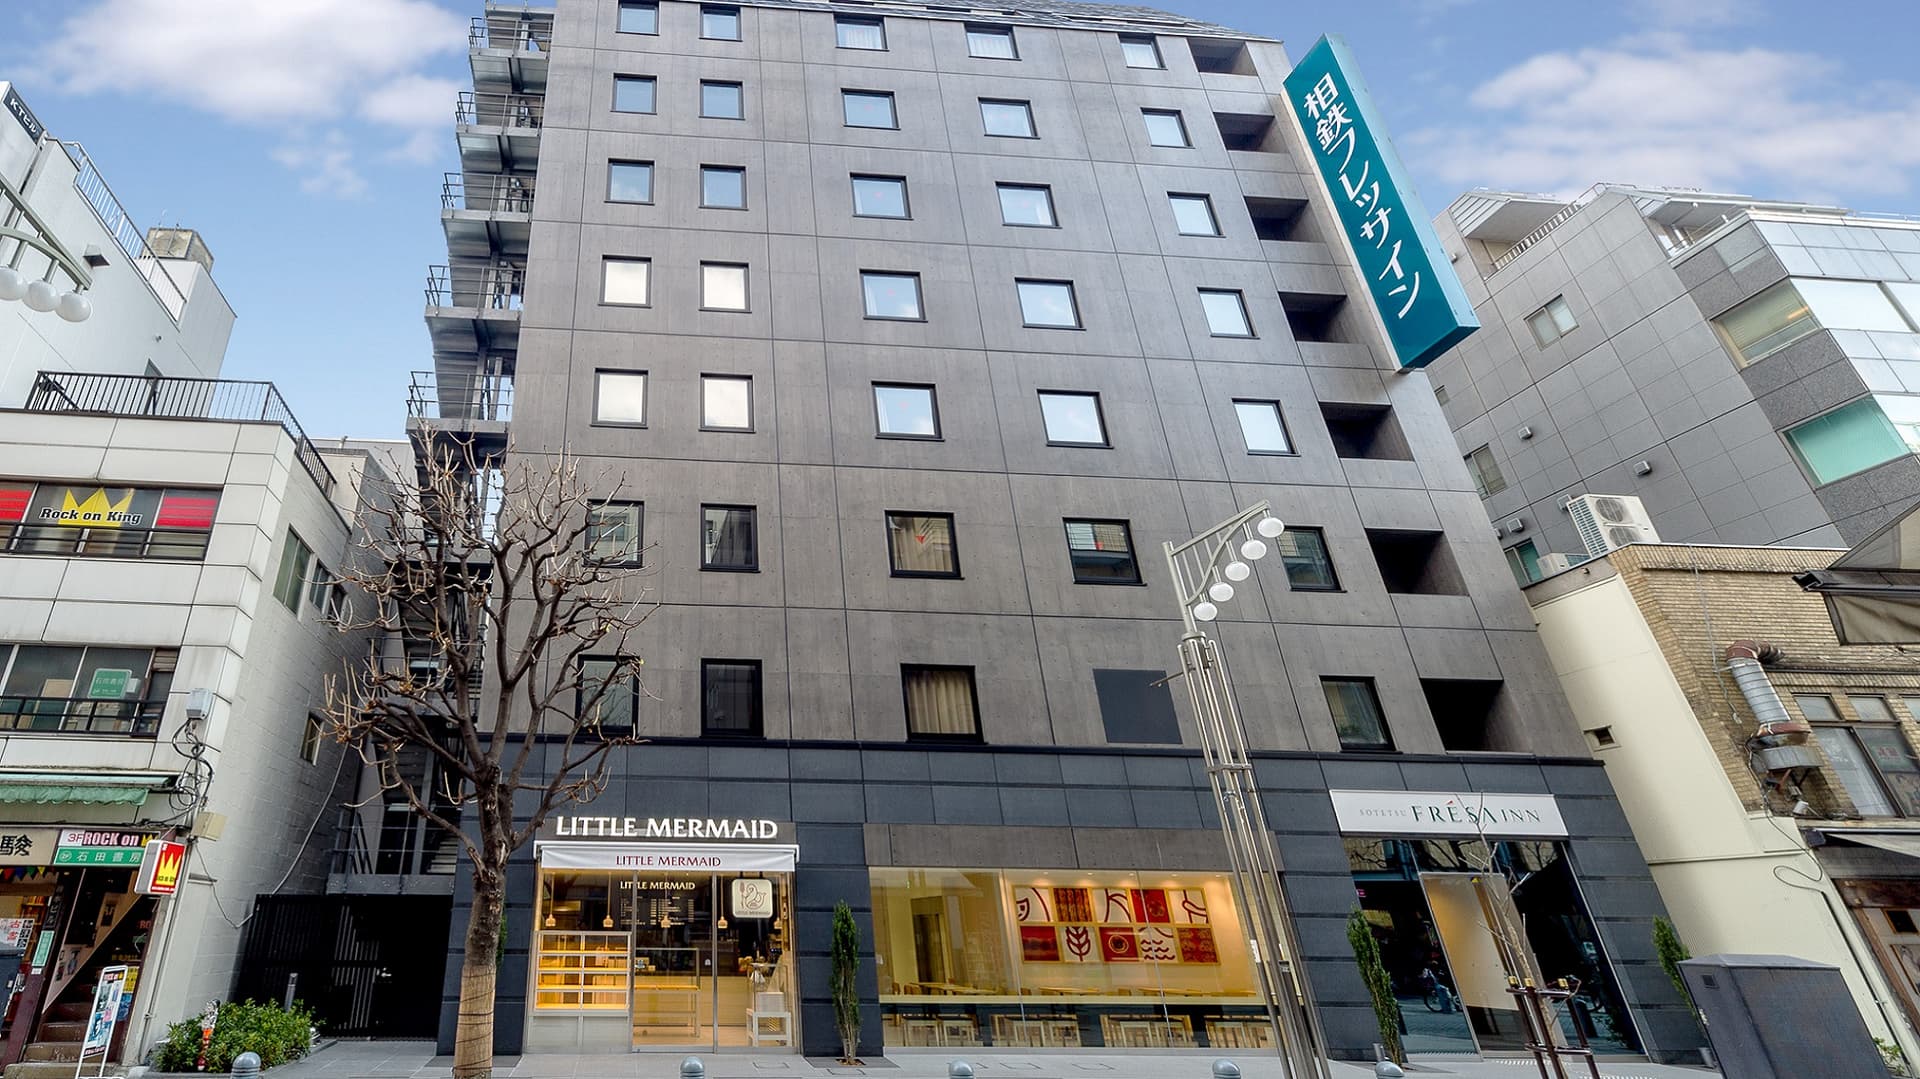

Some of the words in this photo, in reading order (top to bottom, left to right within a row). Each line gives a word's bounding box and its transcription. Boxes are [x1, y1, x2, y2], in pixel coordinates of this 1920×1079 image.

[1303, 72, 1419, 319] 相鉄フレッサイン
[39, 507, 79, 520] Rock
[82, 511, 101, 521] on
[106, 511, 142, 525] King
[1359, 808, 1406, 817] SOTETSU
[1501, 808, 1541, 823] INN
[556, 816, 638, 837] LITTLE
[646, 818, 778, 839] MERMAID
[83, 832, 120, 846] ROCK
[121, 834, 139, 846] on
[76, 851, 142, 862] 石田書房
[616, 855, 654, 866] LITTLE
[658, 856, 721, 867] MERMAID
[620, 881, 648, 890] LITLE
[649, 881, 696, 891] MERMAID
